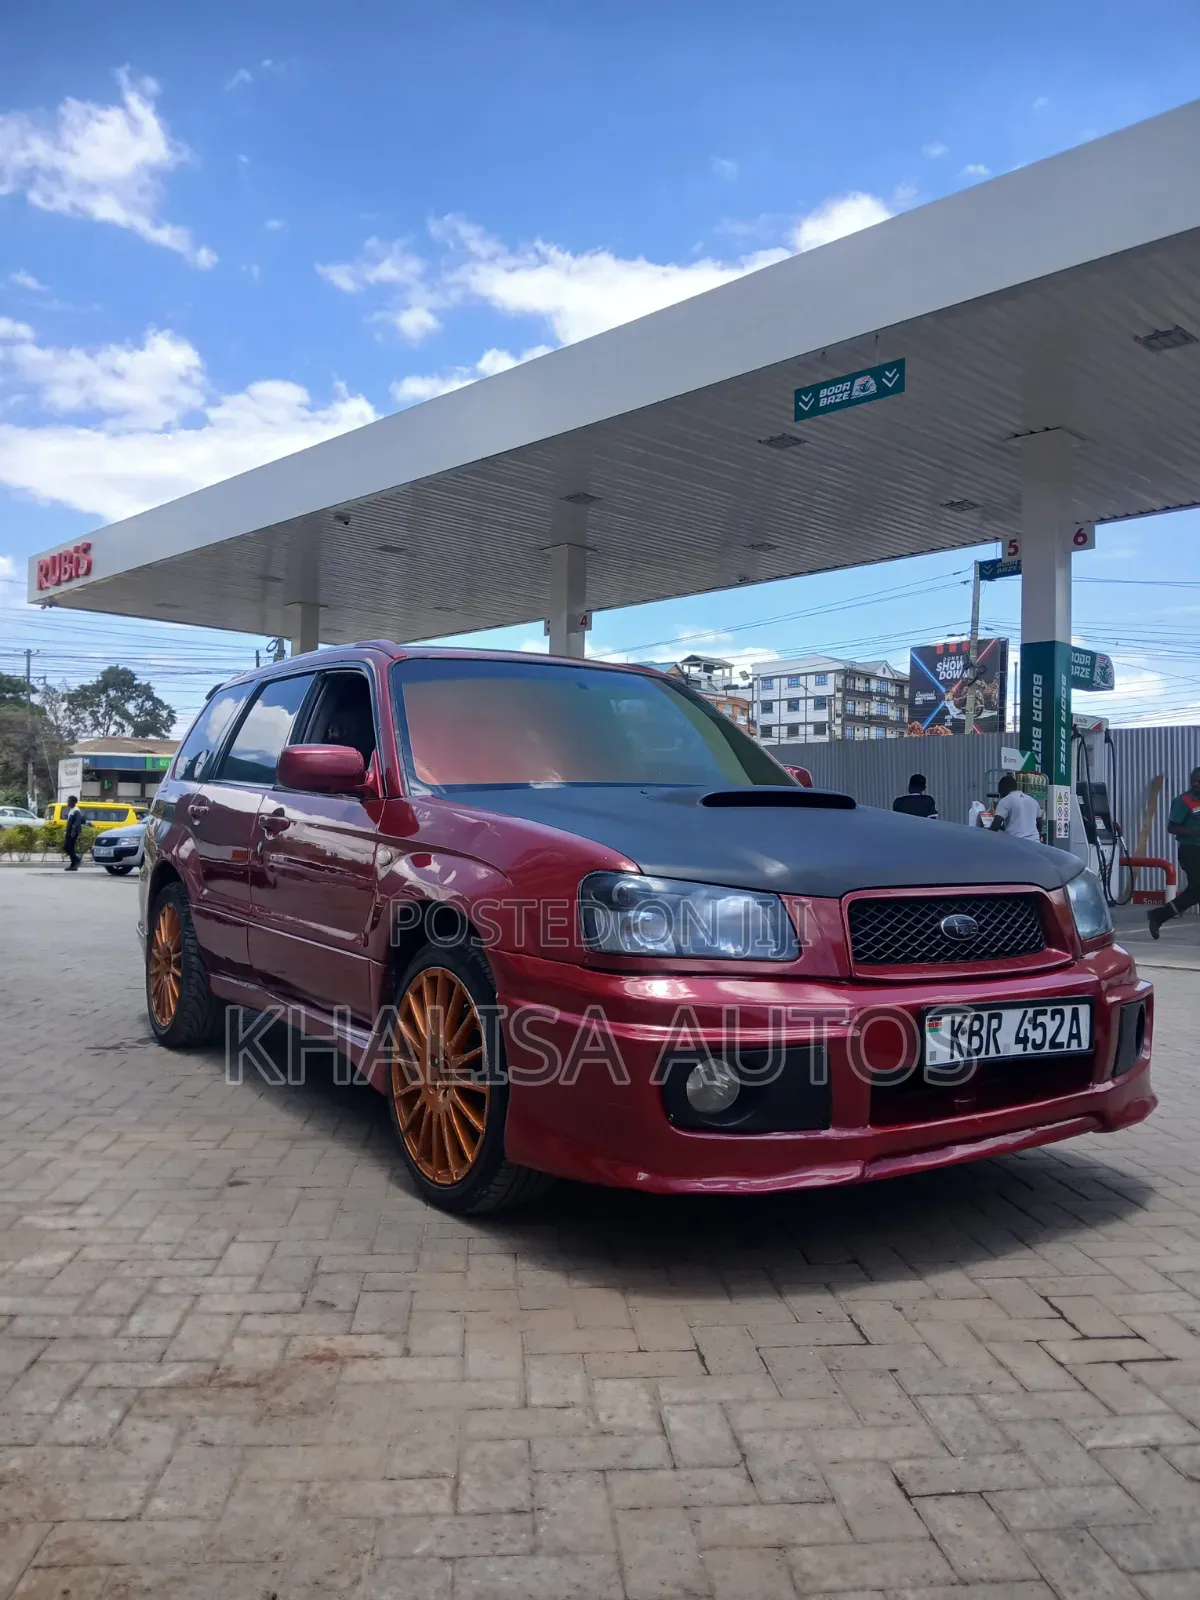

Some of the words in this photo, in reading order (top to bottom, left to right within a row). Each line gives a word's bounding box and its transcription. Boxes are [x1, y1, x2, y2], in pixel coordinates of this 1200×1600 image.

[819, 381, 851, 398] BODA
[819, 391, 850, 407] BAZE
[1073, 527, 1088, 546] 6
[1007, 538, 1019, 557] 5
[580, 615, 588, 627] 4
[1032, 674, 1042, 722] BODA
[950, 1013, 1003, 1060] KBR
[1014, 1006, 1083, 1052] 452A
